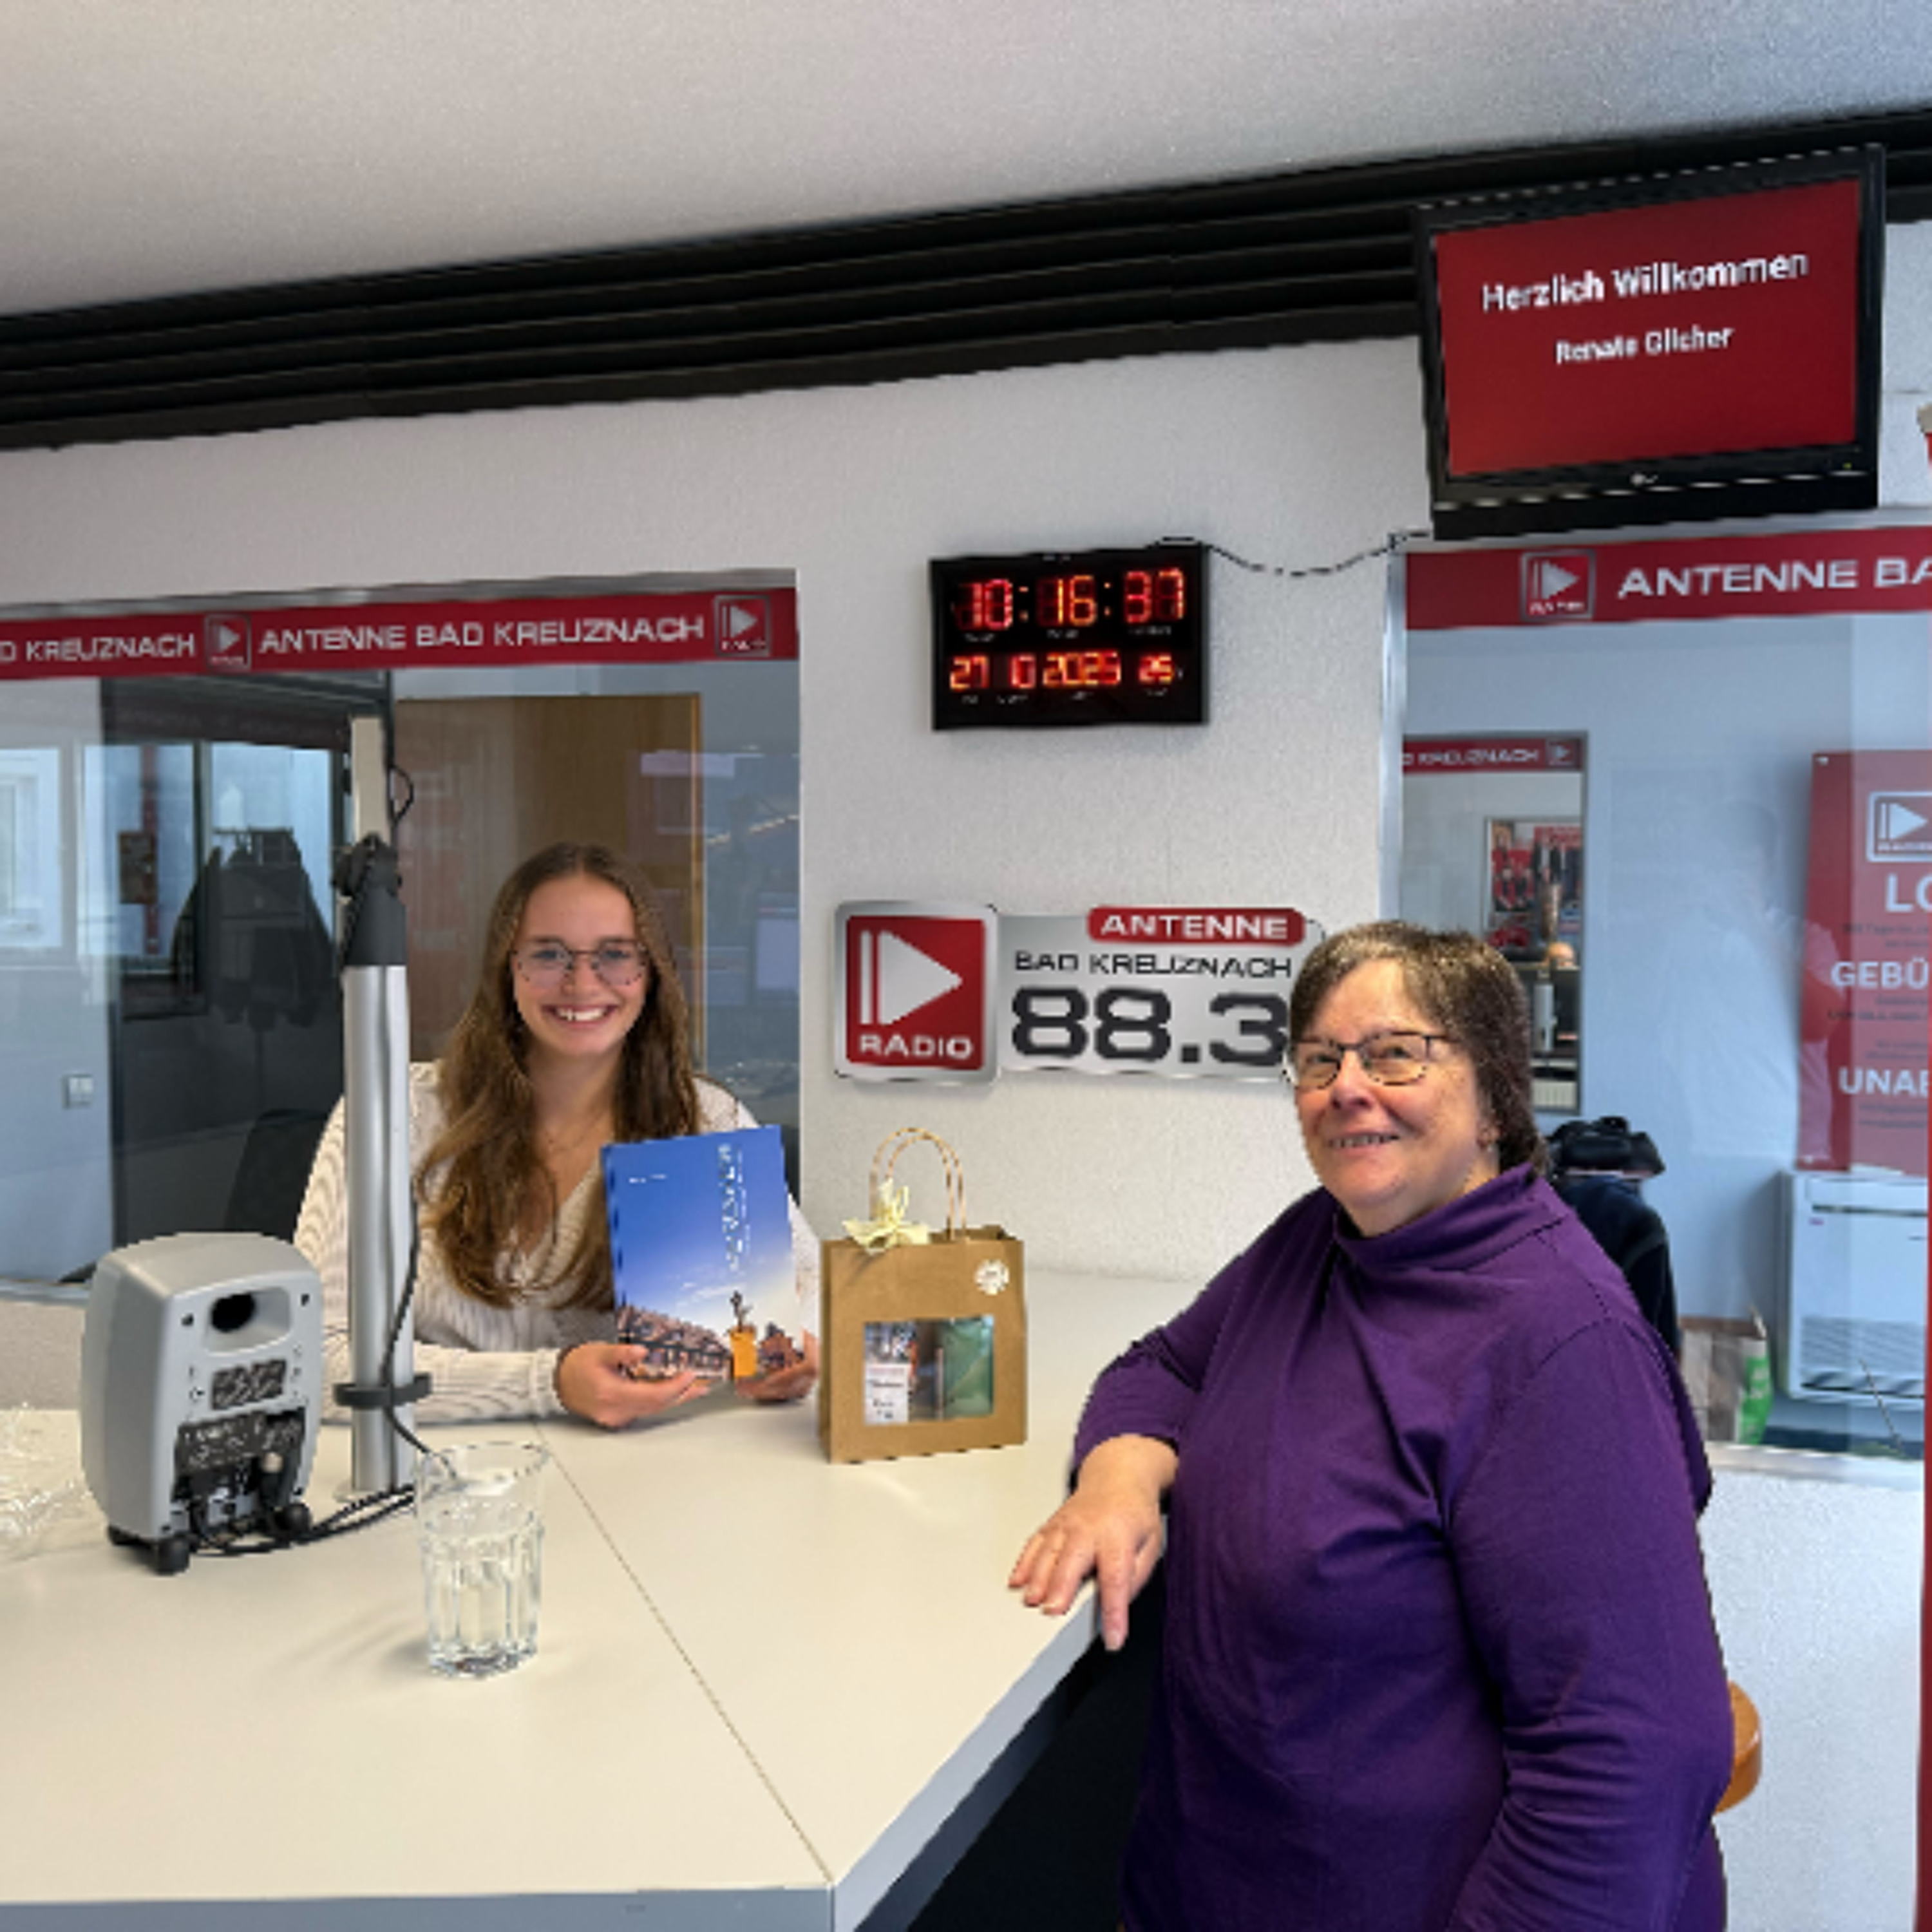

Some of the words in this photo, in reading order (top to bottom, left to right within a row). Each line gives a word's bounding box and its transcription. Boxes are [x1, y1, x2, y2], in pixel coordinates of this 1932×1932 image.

[1482, 270, 1605, 313] Herzlich
[1612, 253, 1808, 298] Willkommen
[1617, 559, 1860, 600] ANTENNE
[26, 634, 195, 662] KREUZNACH
[258, 625, 407, 653] ANTENNE
[415, 621, 484, 647] BAD
[493, 614, 705, 646] KREUZNACH
[1101, 914, 1289, 939] ANTENNE
[1014, 950, 1079, 971] BAD
[1089, 954, 1291, 978] KREUZNACH
[1011, 985, 1289, 1066] 88.3
[859, 1035, 973, 1059] RADIO
